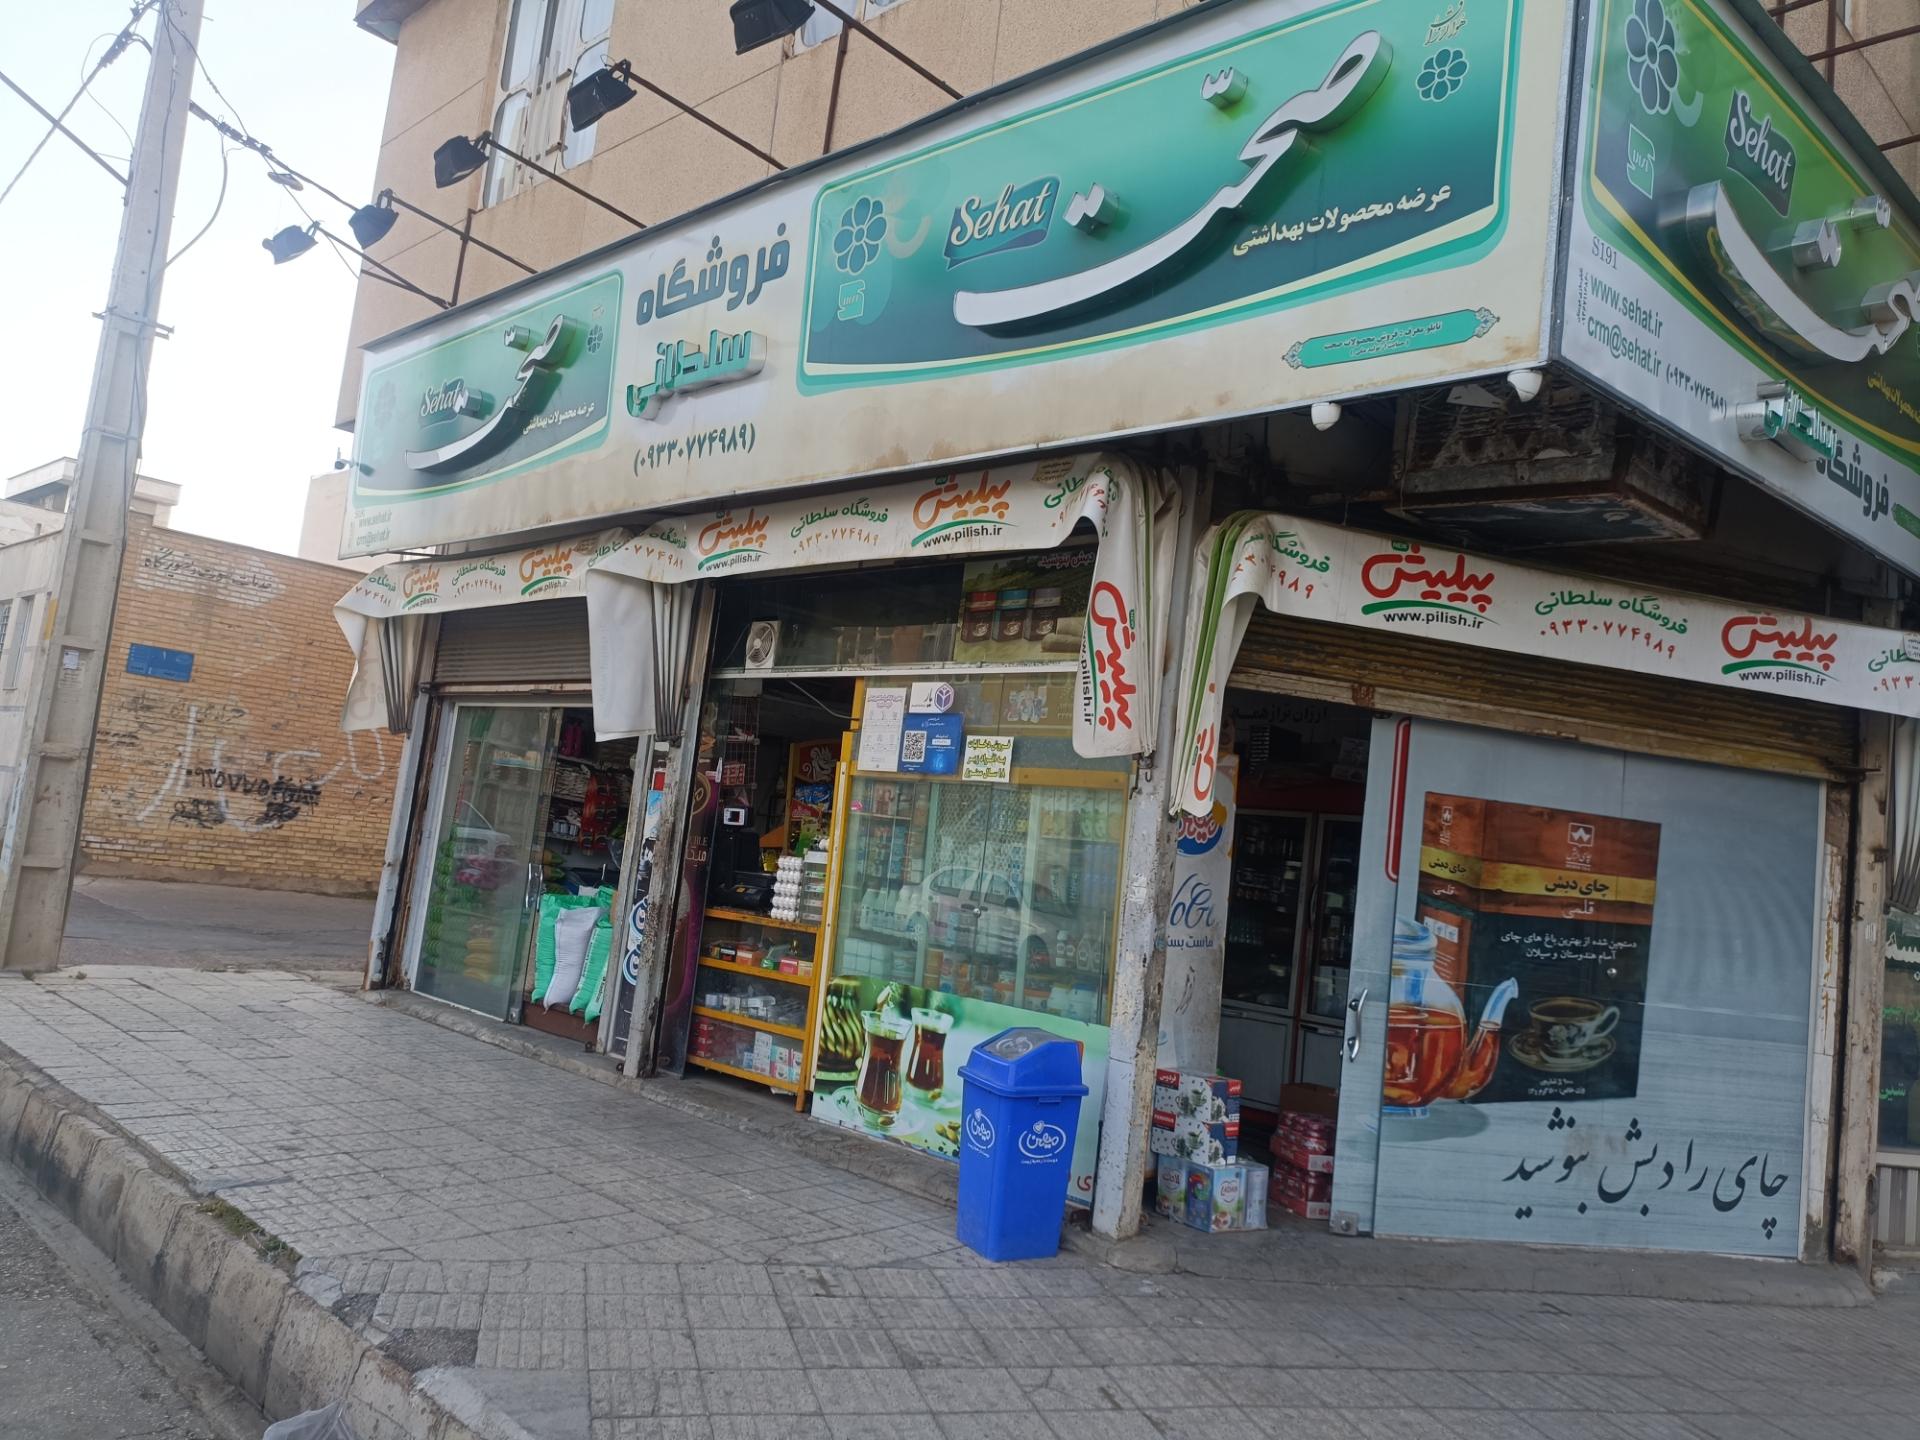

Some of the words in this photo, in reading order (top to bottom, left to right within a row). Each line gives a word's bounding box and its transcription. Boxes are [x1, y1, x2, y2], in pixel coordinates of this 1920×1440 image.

[1731, 91, 1794, 190] Sehat
[1397, 184, 1452, 212] عرضه
[951, 180, 1052, 247] Sehat
[1306, 202, 1394, 233] محصولات
[1232, 220, 1305, 256] بهداشتی
[636, 222, 791, 326] فروشگاه
[1590, 274, 1663, 339] www.sehat.ir
[1587, 316, 1662, 377] crm@sehat.ir
[633, 422, 756, 478] (۰۹۳۳۰۷۷۴۹۸۹)
[789, 507, 839, 539] سلطانی
[840, 497, 889, 524] فروشگاه
[922, 524, 1003, 550] www.pilish.ir
[451, 562, 479, 586] سلطانی
[479, 557, 507, 578] فروشگاه
[705, 553, 762, 573] www.pilish.ir
[527, 580, 569, 598] www.pilish.ir
[1535, 589, 1613, 616] سلطانی
[1383, 611, 1484, 630] www.pilish.ir
[1617, 594, 1689, 635] فروشگاه
[1540, 618, 1676, 660] ۰۹۳۳۰۷۷۴۹۸۹
[1738, 667, 1827, 688] www.pilish.ir
[1544, 875, 1579, 892] دبش
[1578, 878, 1610, 897] چای
[1562, 899, 1595, 919] قلمی
[1500, 931, 1522, 944] چای
[1523, 932, 1542, 944] های
[1501, 1106, 1590, 1220] بنوشید
[1597, 1117, 1674, 1217] دبش
[1684, 1137, 1709, 1192] را
[1712, 1152, 1789, 1240] چای
